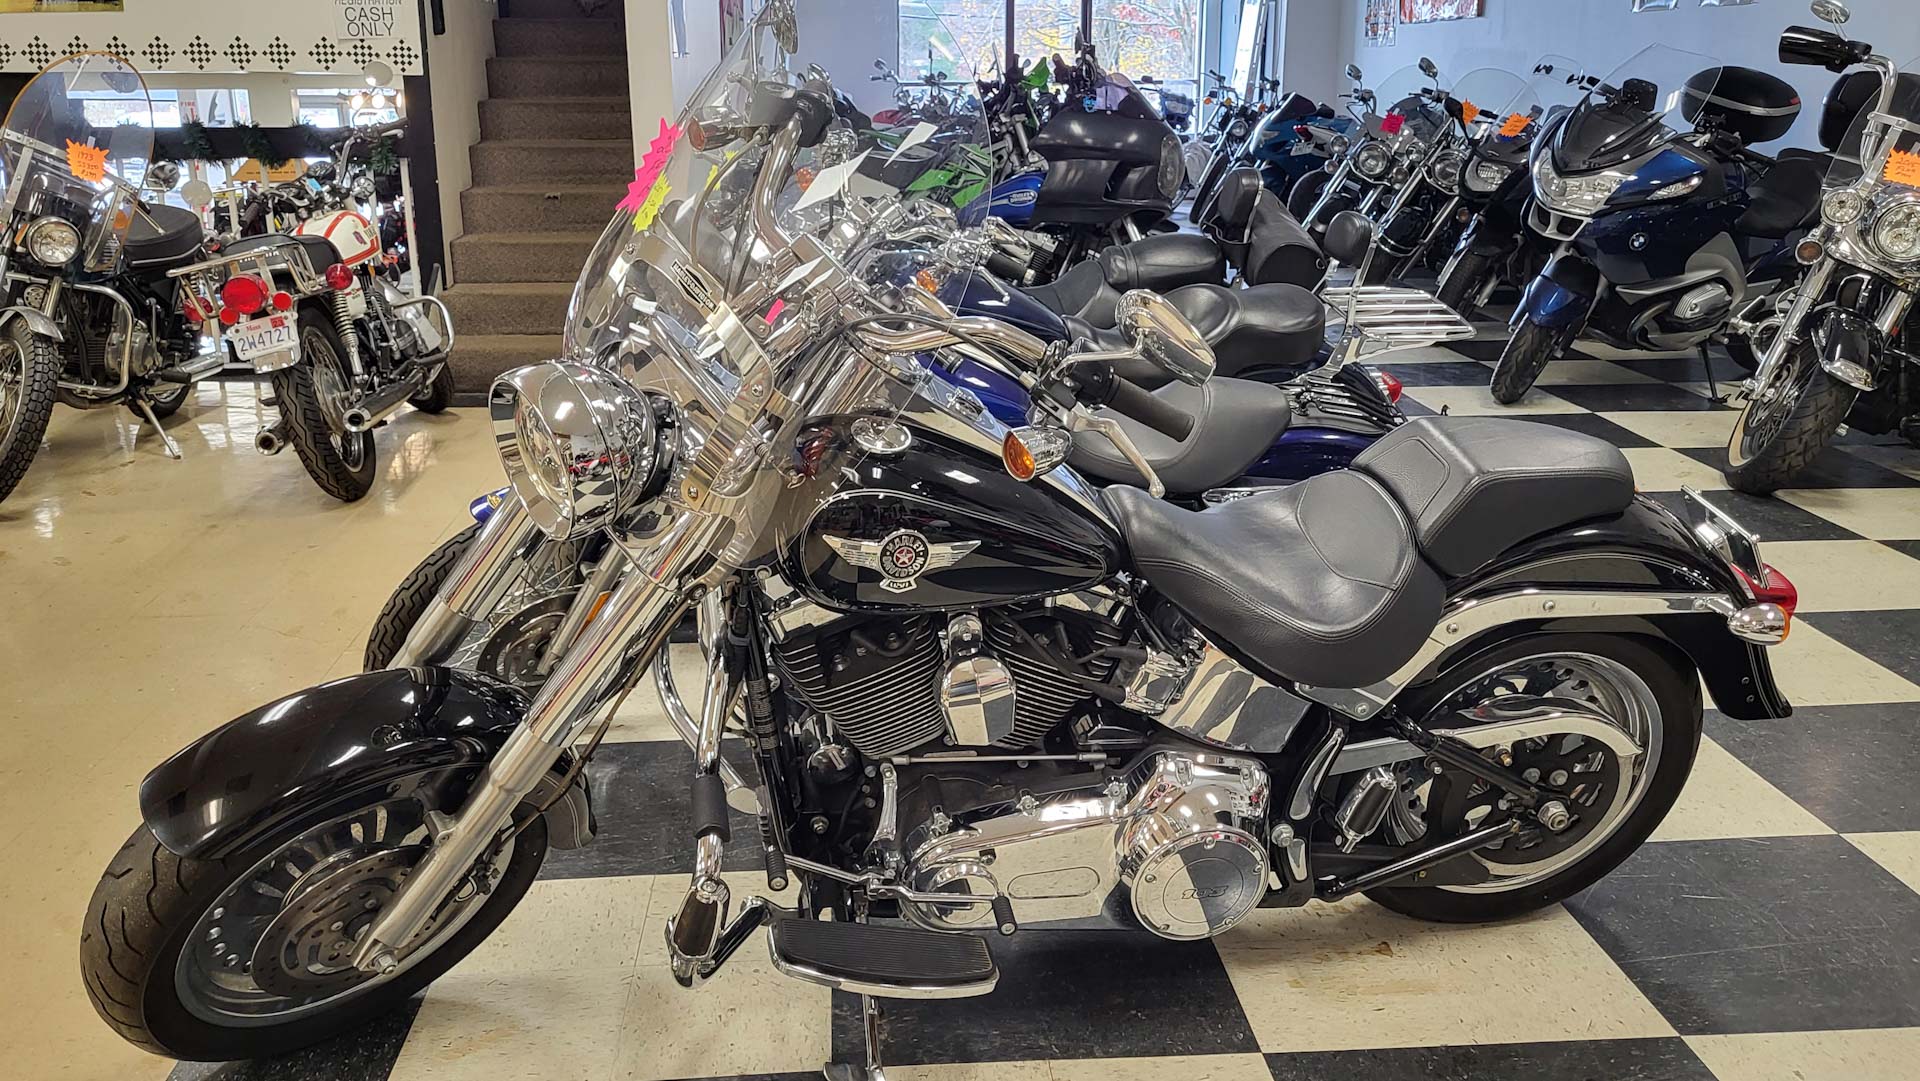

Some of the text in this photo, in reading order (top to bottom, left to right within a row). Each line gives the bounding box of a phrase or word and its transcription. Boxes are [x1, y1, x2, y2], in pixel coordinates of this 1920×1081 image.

[344, 7, 394, 21] CASH
[347, 22, 394, 37] ONLY
[886, 535, 925, 553] HARLEY
[882, 556, 925, 577] DAVIDSON
